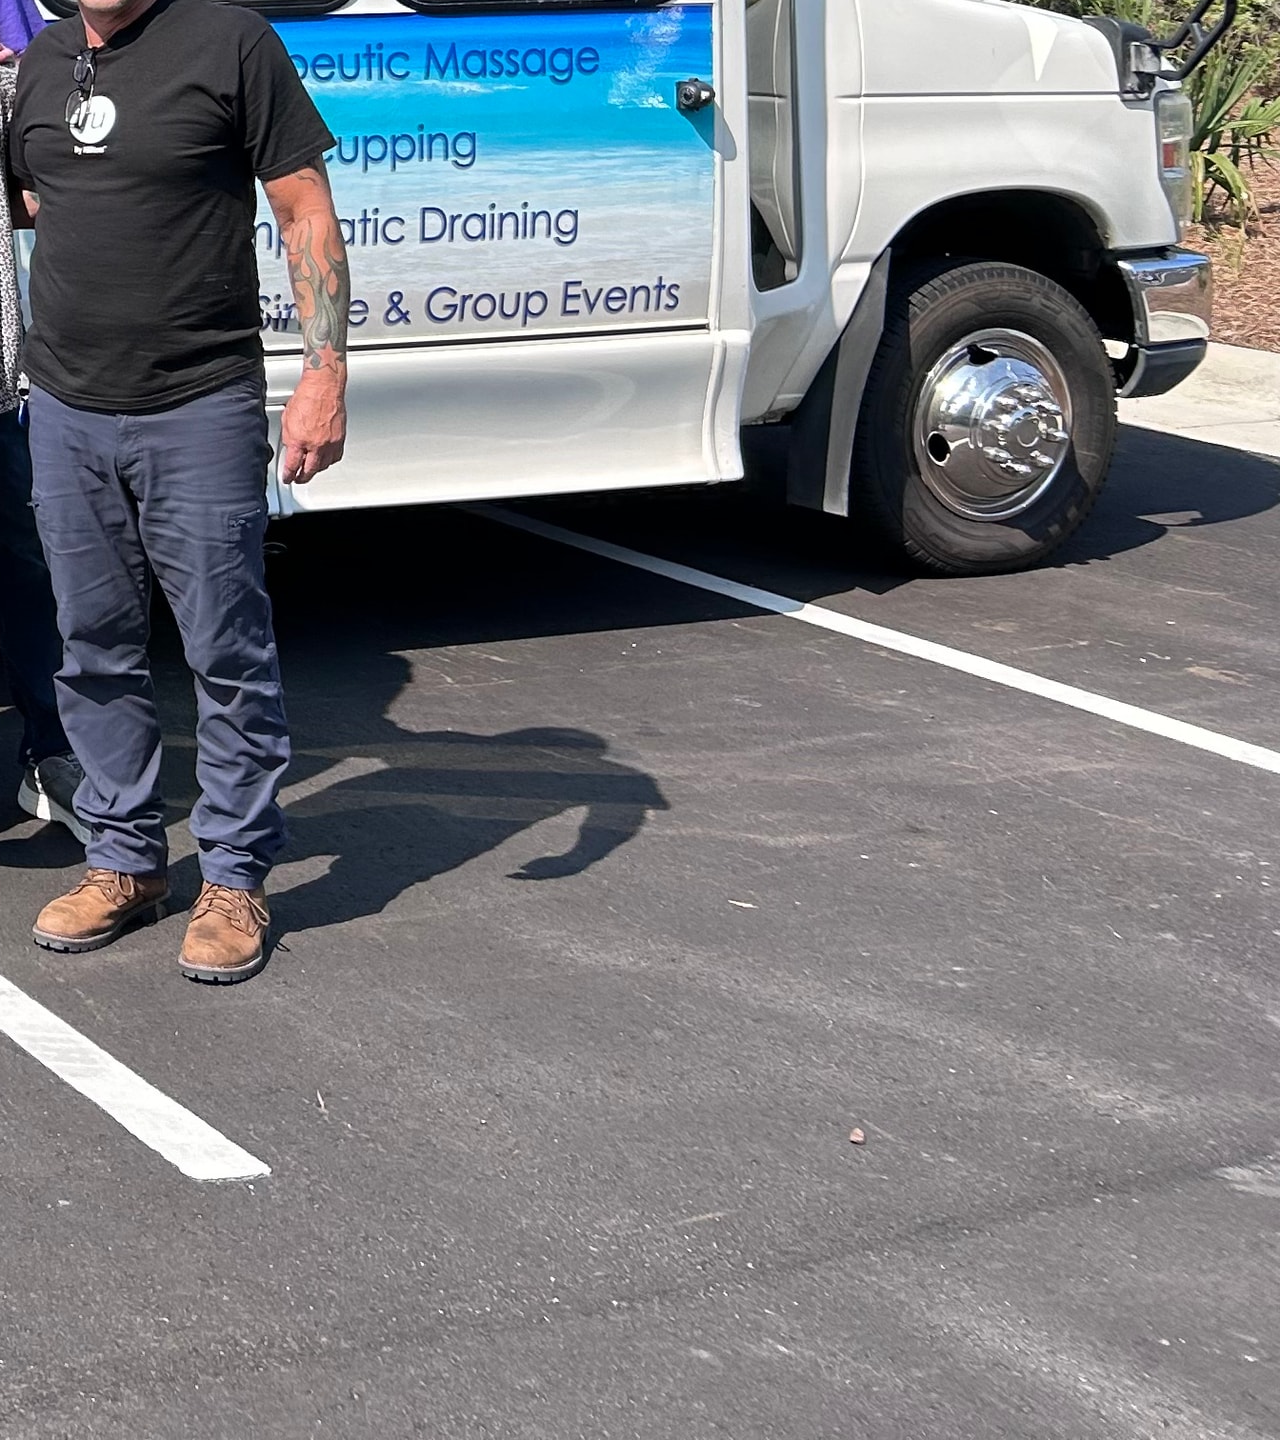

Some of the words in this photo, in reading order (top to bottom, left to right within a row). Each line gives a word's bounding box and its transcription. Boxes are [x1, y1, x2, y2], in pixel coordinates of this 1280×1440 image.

[423, 40, 600, 85] Massage
[325, 123, 478, 170] upping
[419, 201, 580, 247] Draining
[382, 290, 413, 327] &
[423, 285, 549, 328] Group
[559, 275, 681, 318] Events
